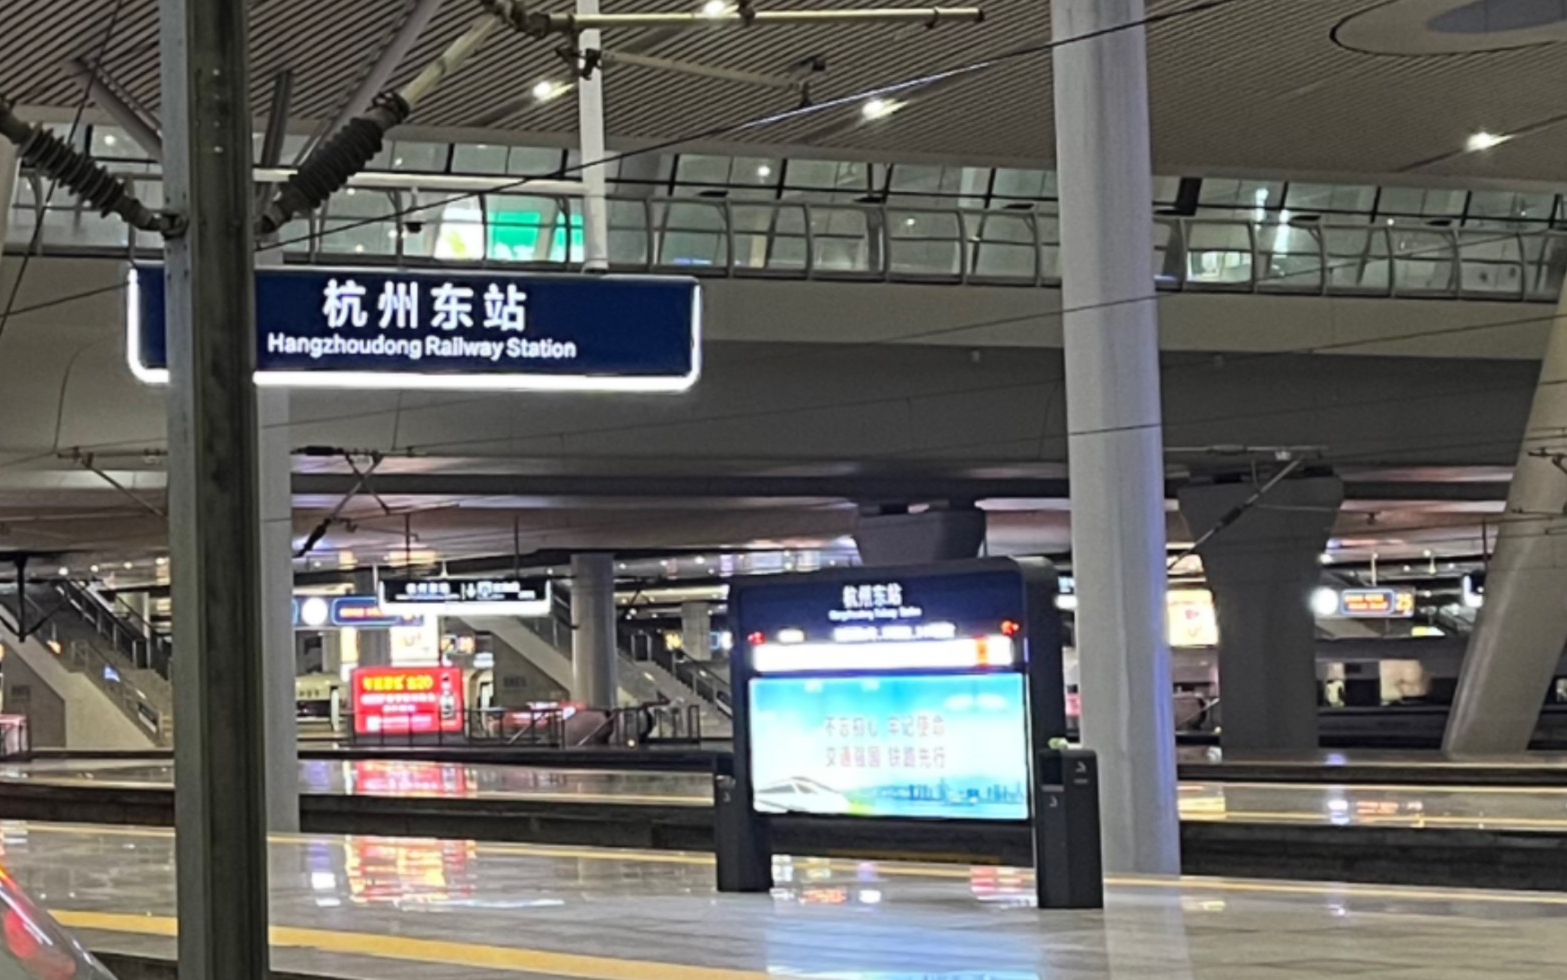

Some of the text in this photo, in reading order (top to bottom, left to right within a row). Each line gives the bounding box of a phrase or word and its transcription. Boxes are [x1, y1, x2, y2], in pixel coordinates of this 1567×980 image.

[323, 279, 527, 331] 杭州东站
[267, 332, 576, 359] Hangzhoudong Railway Station
